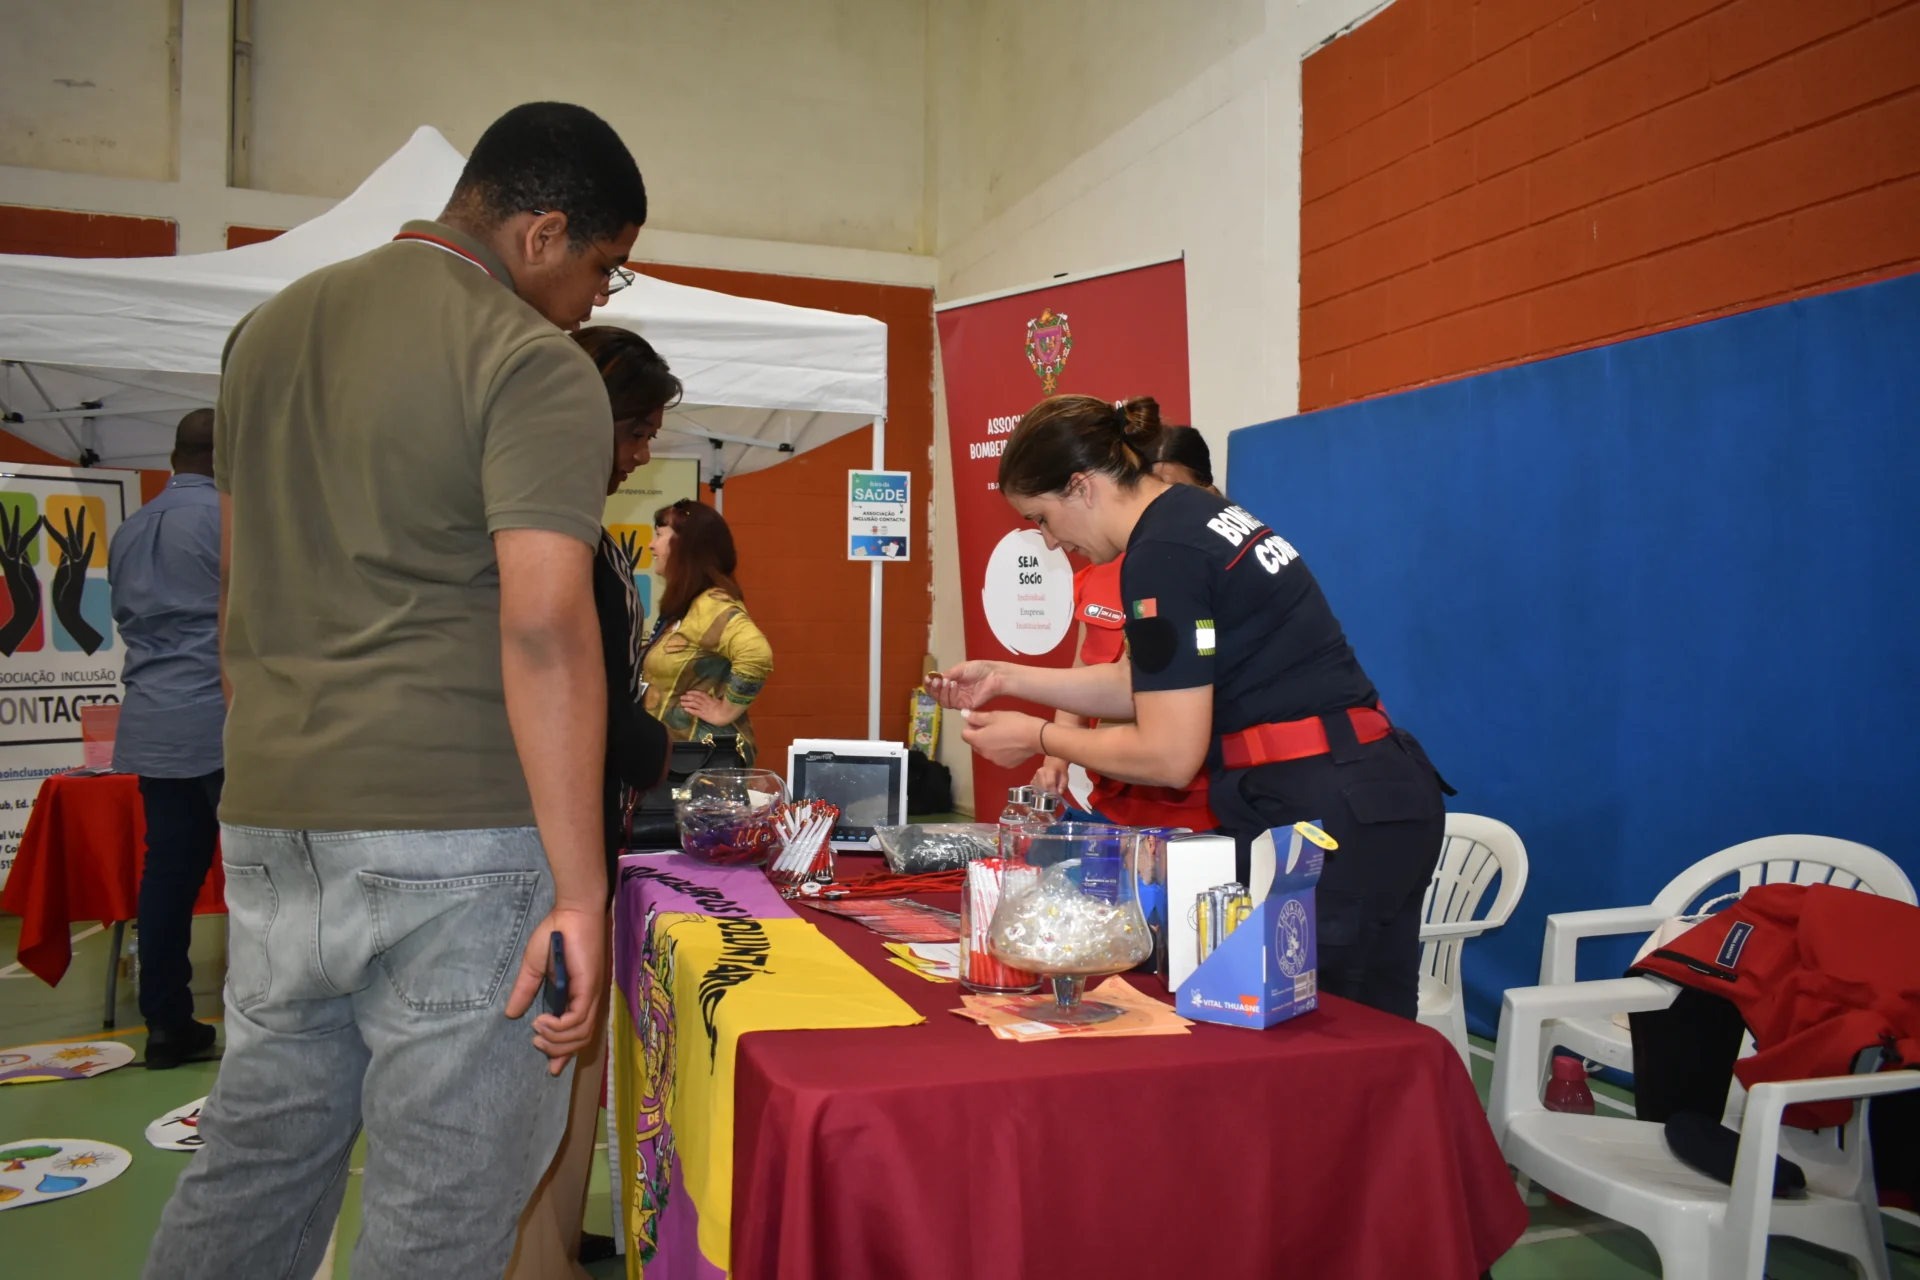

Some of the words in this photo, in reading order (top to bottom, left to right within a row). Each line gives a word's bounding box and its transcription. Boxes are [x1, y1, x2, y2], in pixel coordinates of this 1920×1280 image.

[1018, 556, 1039, 568] SEJA
[1017, 593, 1045, 601] Individual
[1020, 608, 1045, 616] Empresa
[1016, 622, 1051, 630] Institucional
[61, 668, 116, 682] INCLUSÃO
[16, 799, 29, 809] Ed.
[1278, 902, 1306, 928] THUASNE
[1203, 999, 1223, 1009] VITAL
[1224, 1001, 1260, 1013] THUASNE
[647, 1112, 661, 1126] DE
